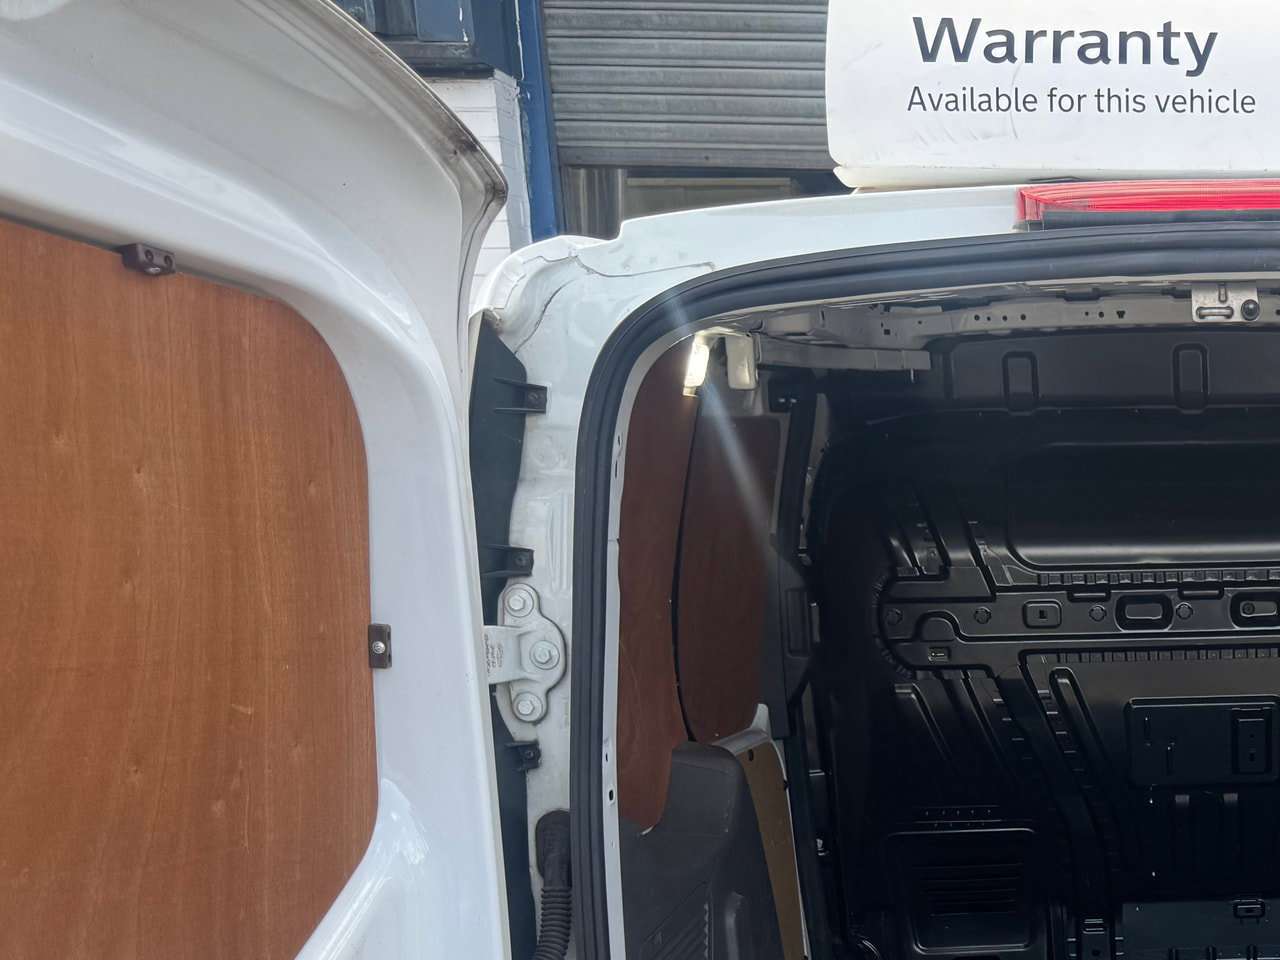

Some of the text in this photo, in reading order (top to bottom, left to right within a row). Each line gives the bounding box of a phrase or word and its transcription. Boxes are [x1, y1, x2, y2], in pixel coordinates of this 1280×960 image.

[912, 16, 1218, 77] Warranty
[907, 86, 1256, 114] Available for this vehicle
